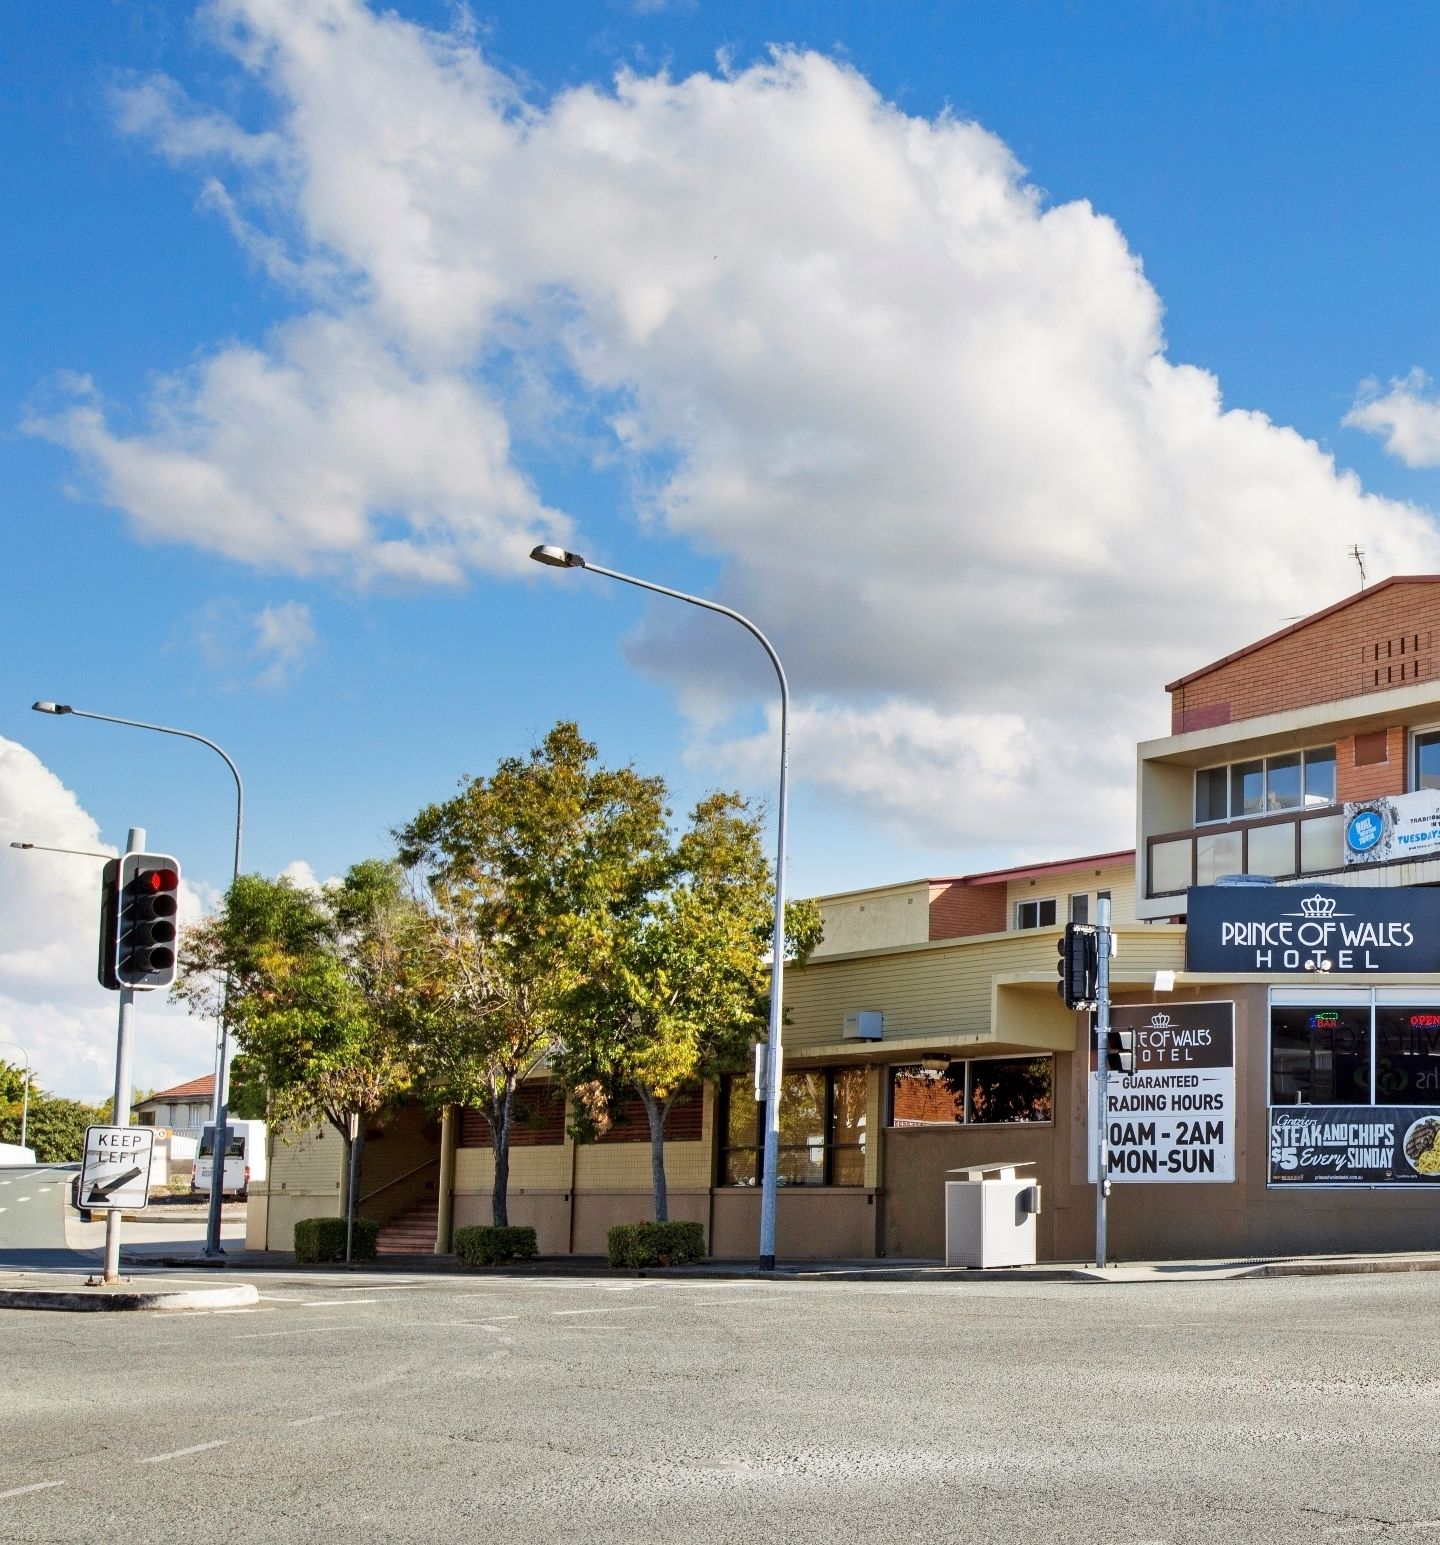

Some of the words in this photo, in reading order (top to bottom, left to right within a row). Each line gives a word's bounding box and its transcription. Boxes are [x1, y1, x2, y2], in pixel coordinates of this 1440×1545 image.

[1221, 922, 1293, 946] PRINCE
[1297, 922, 1336, 946] OF
[1339, 922, 1414, 947] WALES
[1256, 950, 1379, 969] HOTEL
[1317, 1020, 1337, 1028] BAR
[1410, 1015, 1440, 1026] OPEN
[1149, 1031, 1171, 1047] OF
[1172, 1028, 1212, 1047] WALES
[1142, 1048, 1193, 1062] OTEL
[1122, 1075, 1199, 1089] GUARANTEED
[1107, 1094, 1167, 1112] RADING
[1171, 1093, 1224, 1111] HOURS
[1276, 1114, 1318, 1128] Graziers
[98, 1134, 142, 1147] KEEP
[1107, 1122, 1156, 1146] 0AM
[1175, 1121, 1224, 1145] 2AM
[1271, 1124, 1323, 1147] STEAK
[1322, 1124, 1348, 1141] AND
[1348, 1124, 1395, 1146] CHIPS
[98, 1151, 139, 1164] LEFT
[1107, 1149, 1215, 1174] MON-SUN
[1271, 1147, 1299, 1170] $5
[1299, 1148, 1347, 1172] Every
[1347, 1147, 1395, 1169] SUNDAY
